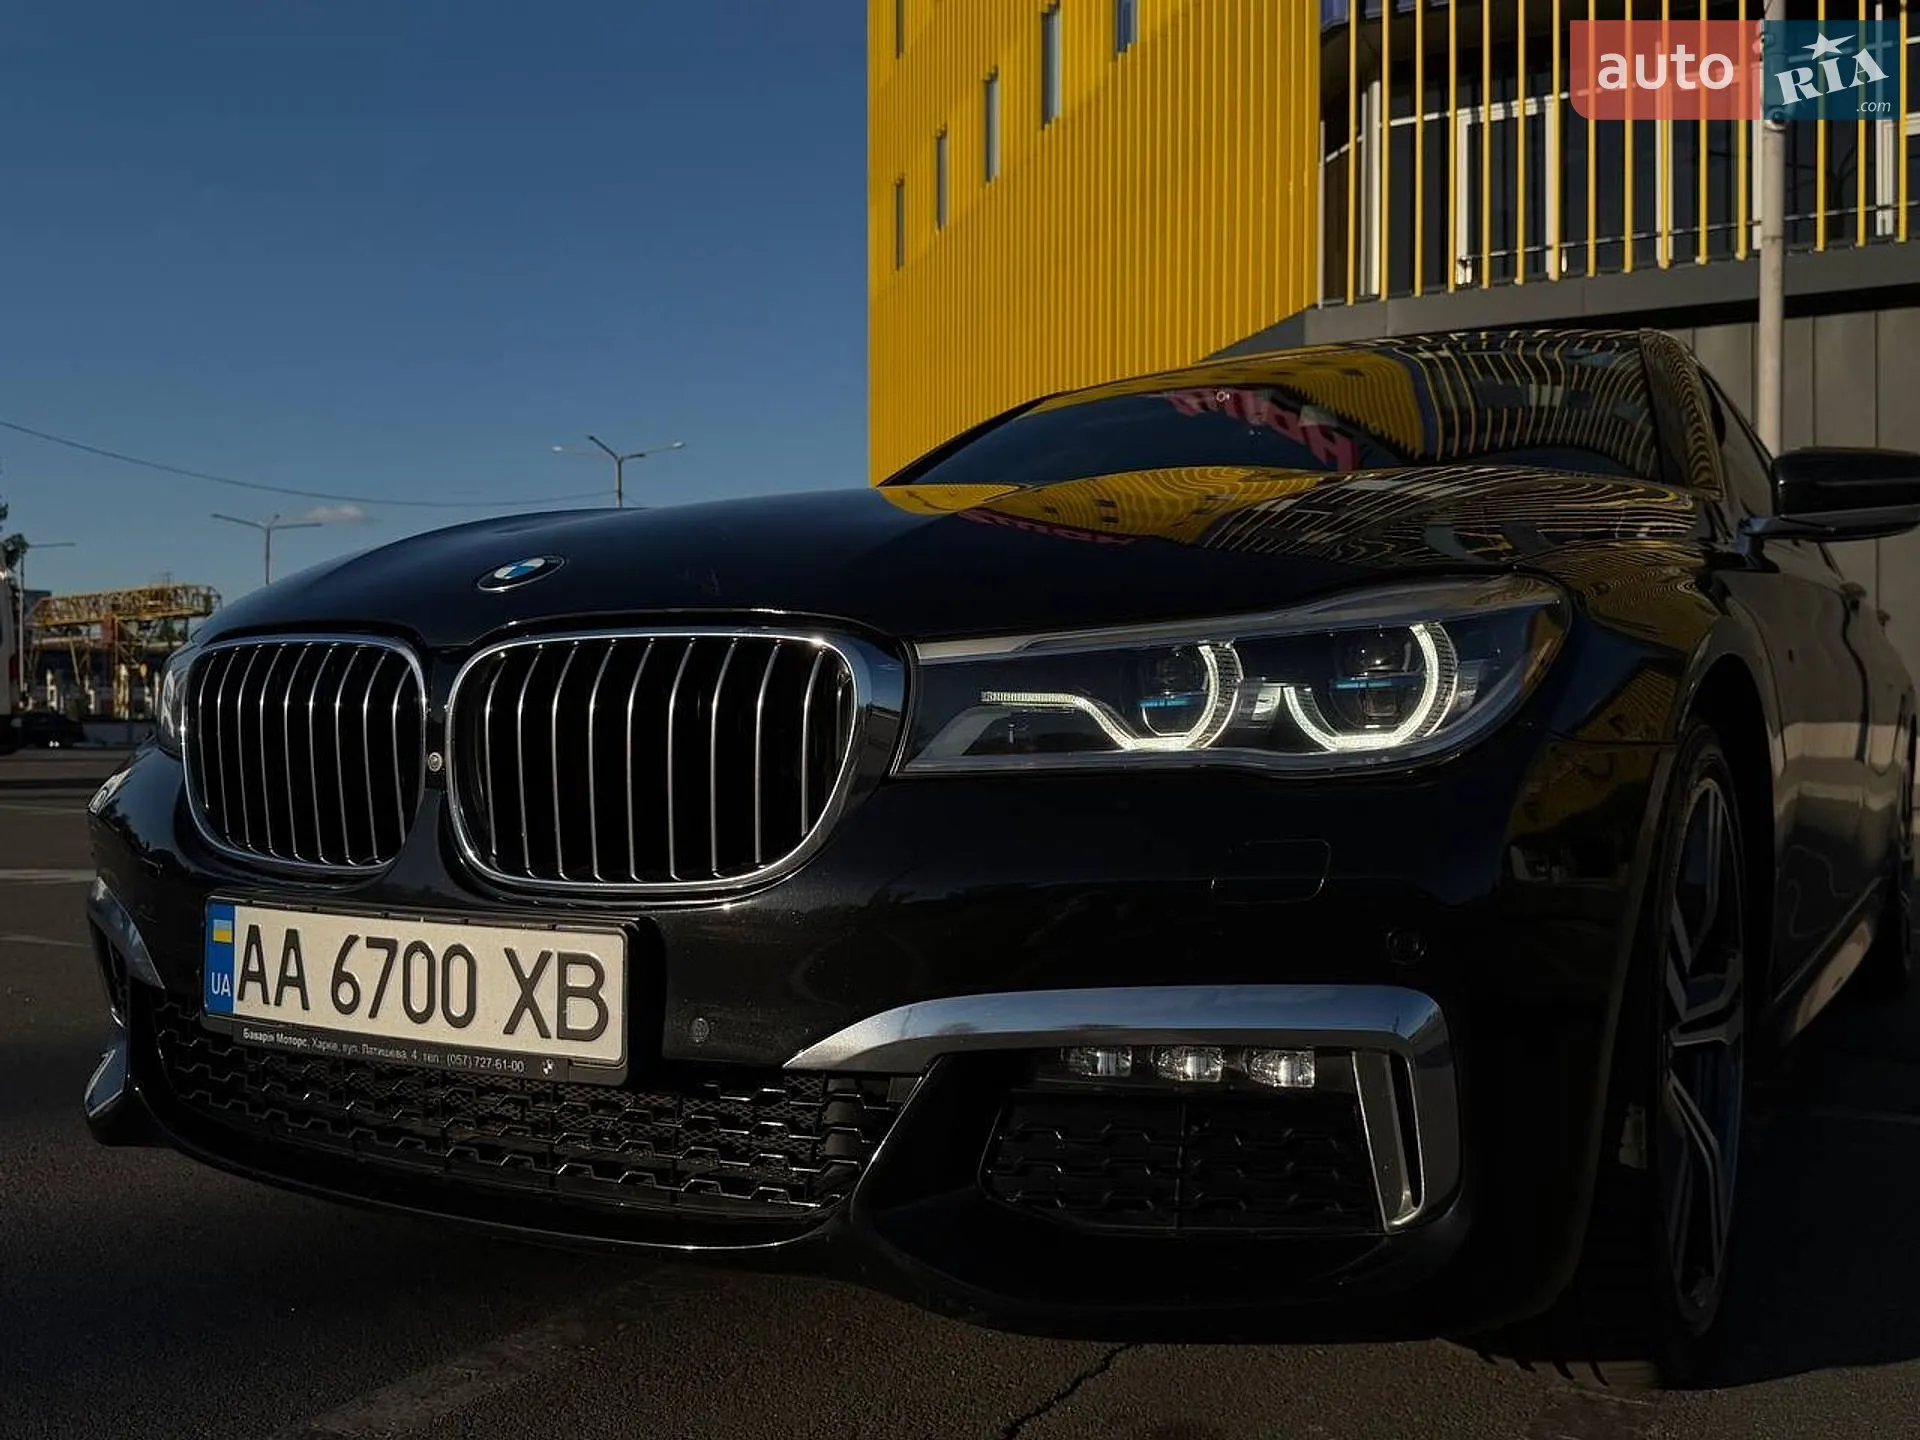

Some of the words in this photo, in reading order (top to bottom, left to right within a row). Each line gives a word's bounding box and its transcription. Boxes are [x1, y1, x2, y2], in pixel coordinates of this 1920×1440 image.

[211, 971, 232, 997] UA
[237, 924, 310, 1011] AA
[331, 934, 477, 1029] 6700
[503, 947, 609, 1041] XB
